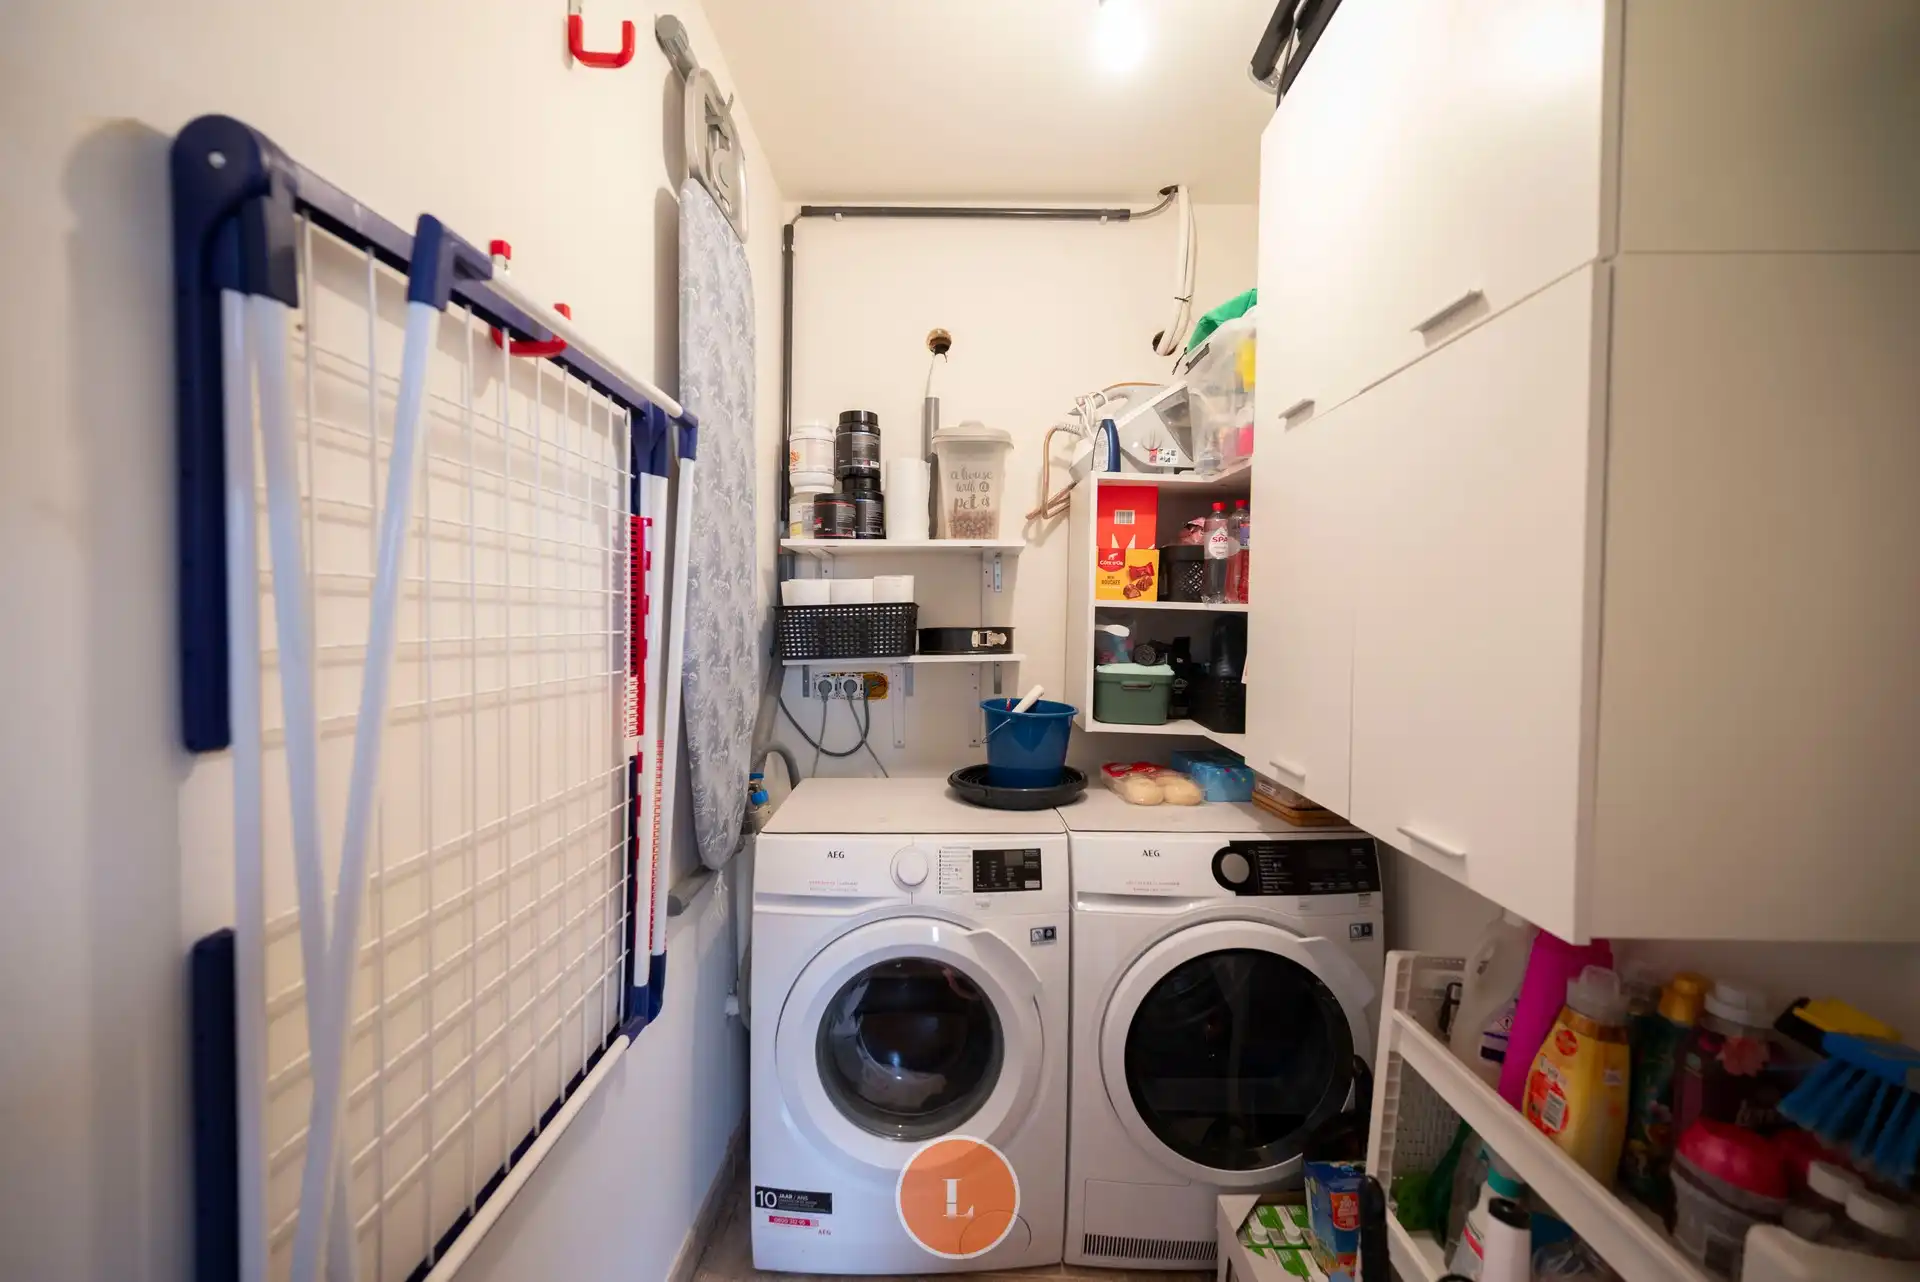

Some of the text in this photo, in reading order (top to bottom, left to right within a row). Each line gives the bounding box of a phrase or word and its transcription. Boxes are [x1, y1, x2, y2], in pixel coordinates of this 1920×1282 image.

[961, 466, 993, 480] house
[954, 494, 978, 513] pet
[827, 851, 845, 859] AEG
[1142, 849, 1160, 857] AEG
[756, 1190, 777, 1208] 10
